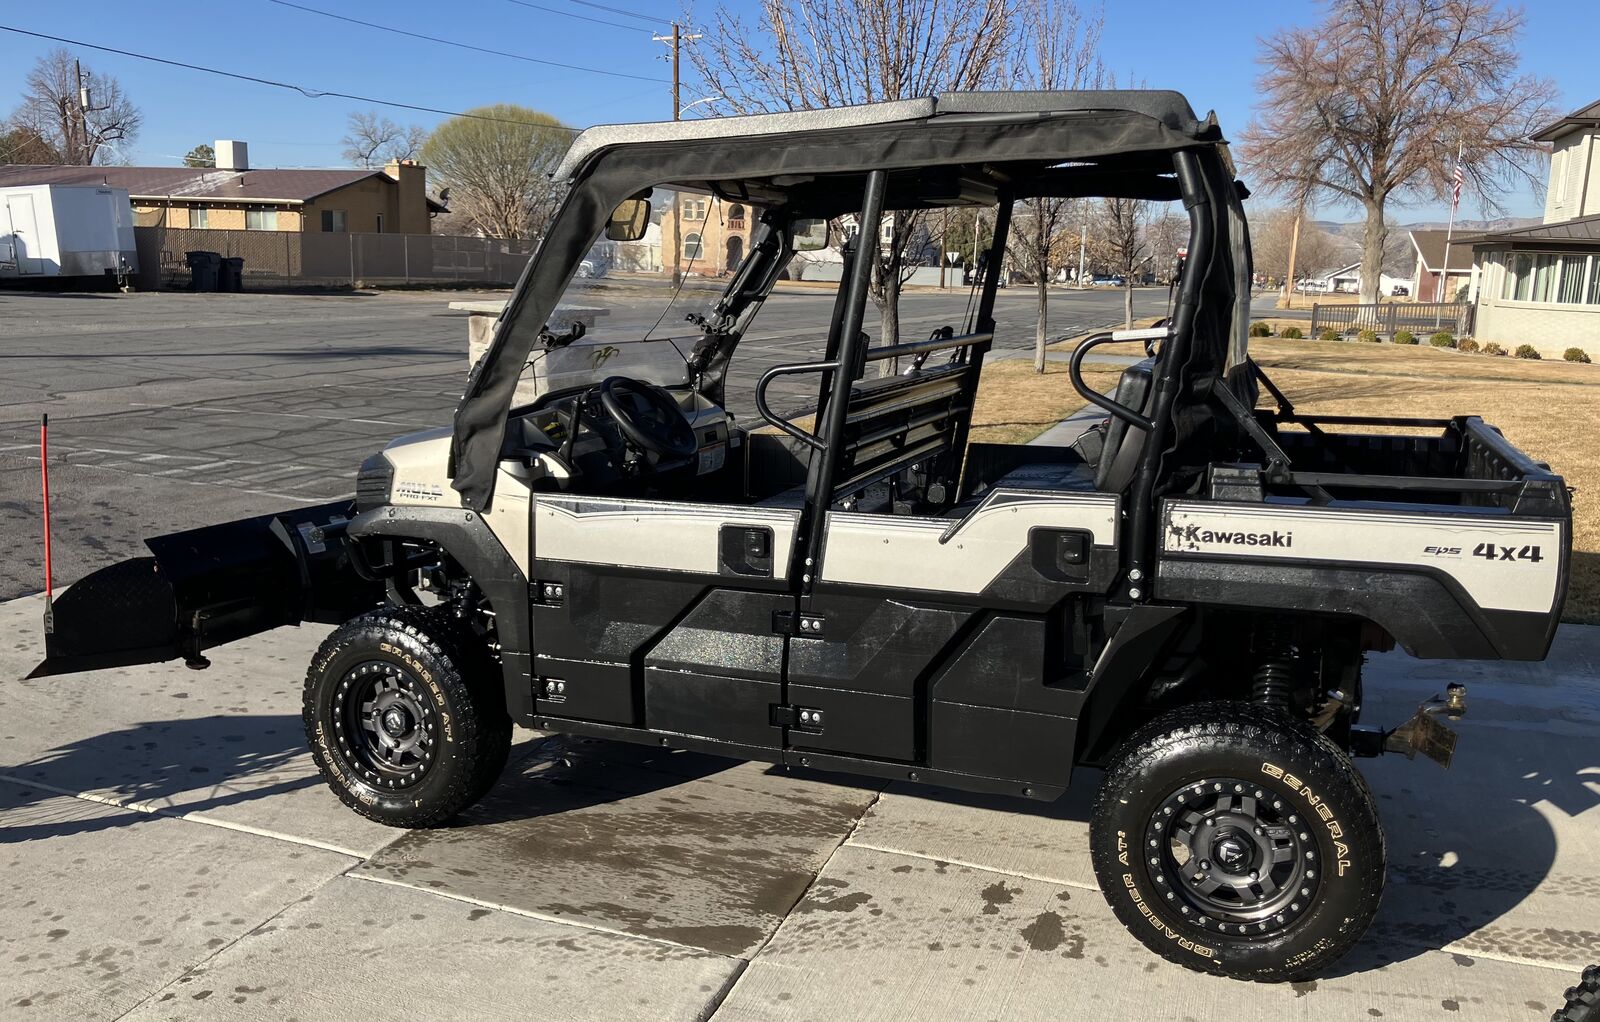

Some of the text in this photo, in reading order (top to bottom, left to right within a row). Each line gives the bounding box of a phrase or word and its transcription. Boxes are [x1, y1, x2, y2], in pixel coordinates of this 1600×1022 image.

[1185, 525, 1293, 548] Kawasaki
[380, 642, 445, 706] GRABBER
[1261, 762, 1351, 877] GENERAL
[1122, 873, 1213, 958] GRABBER
